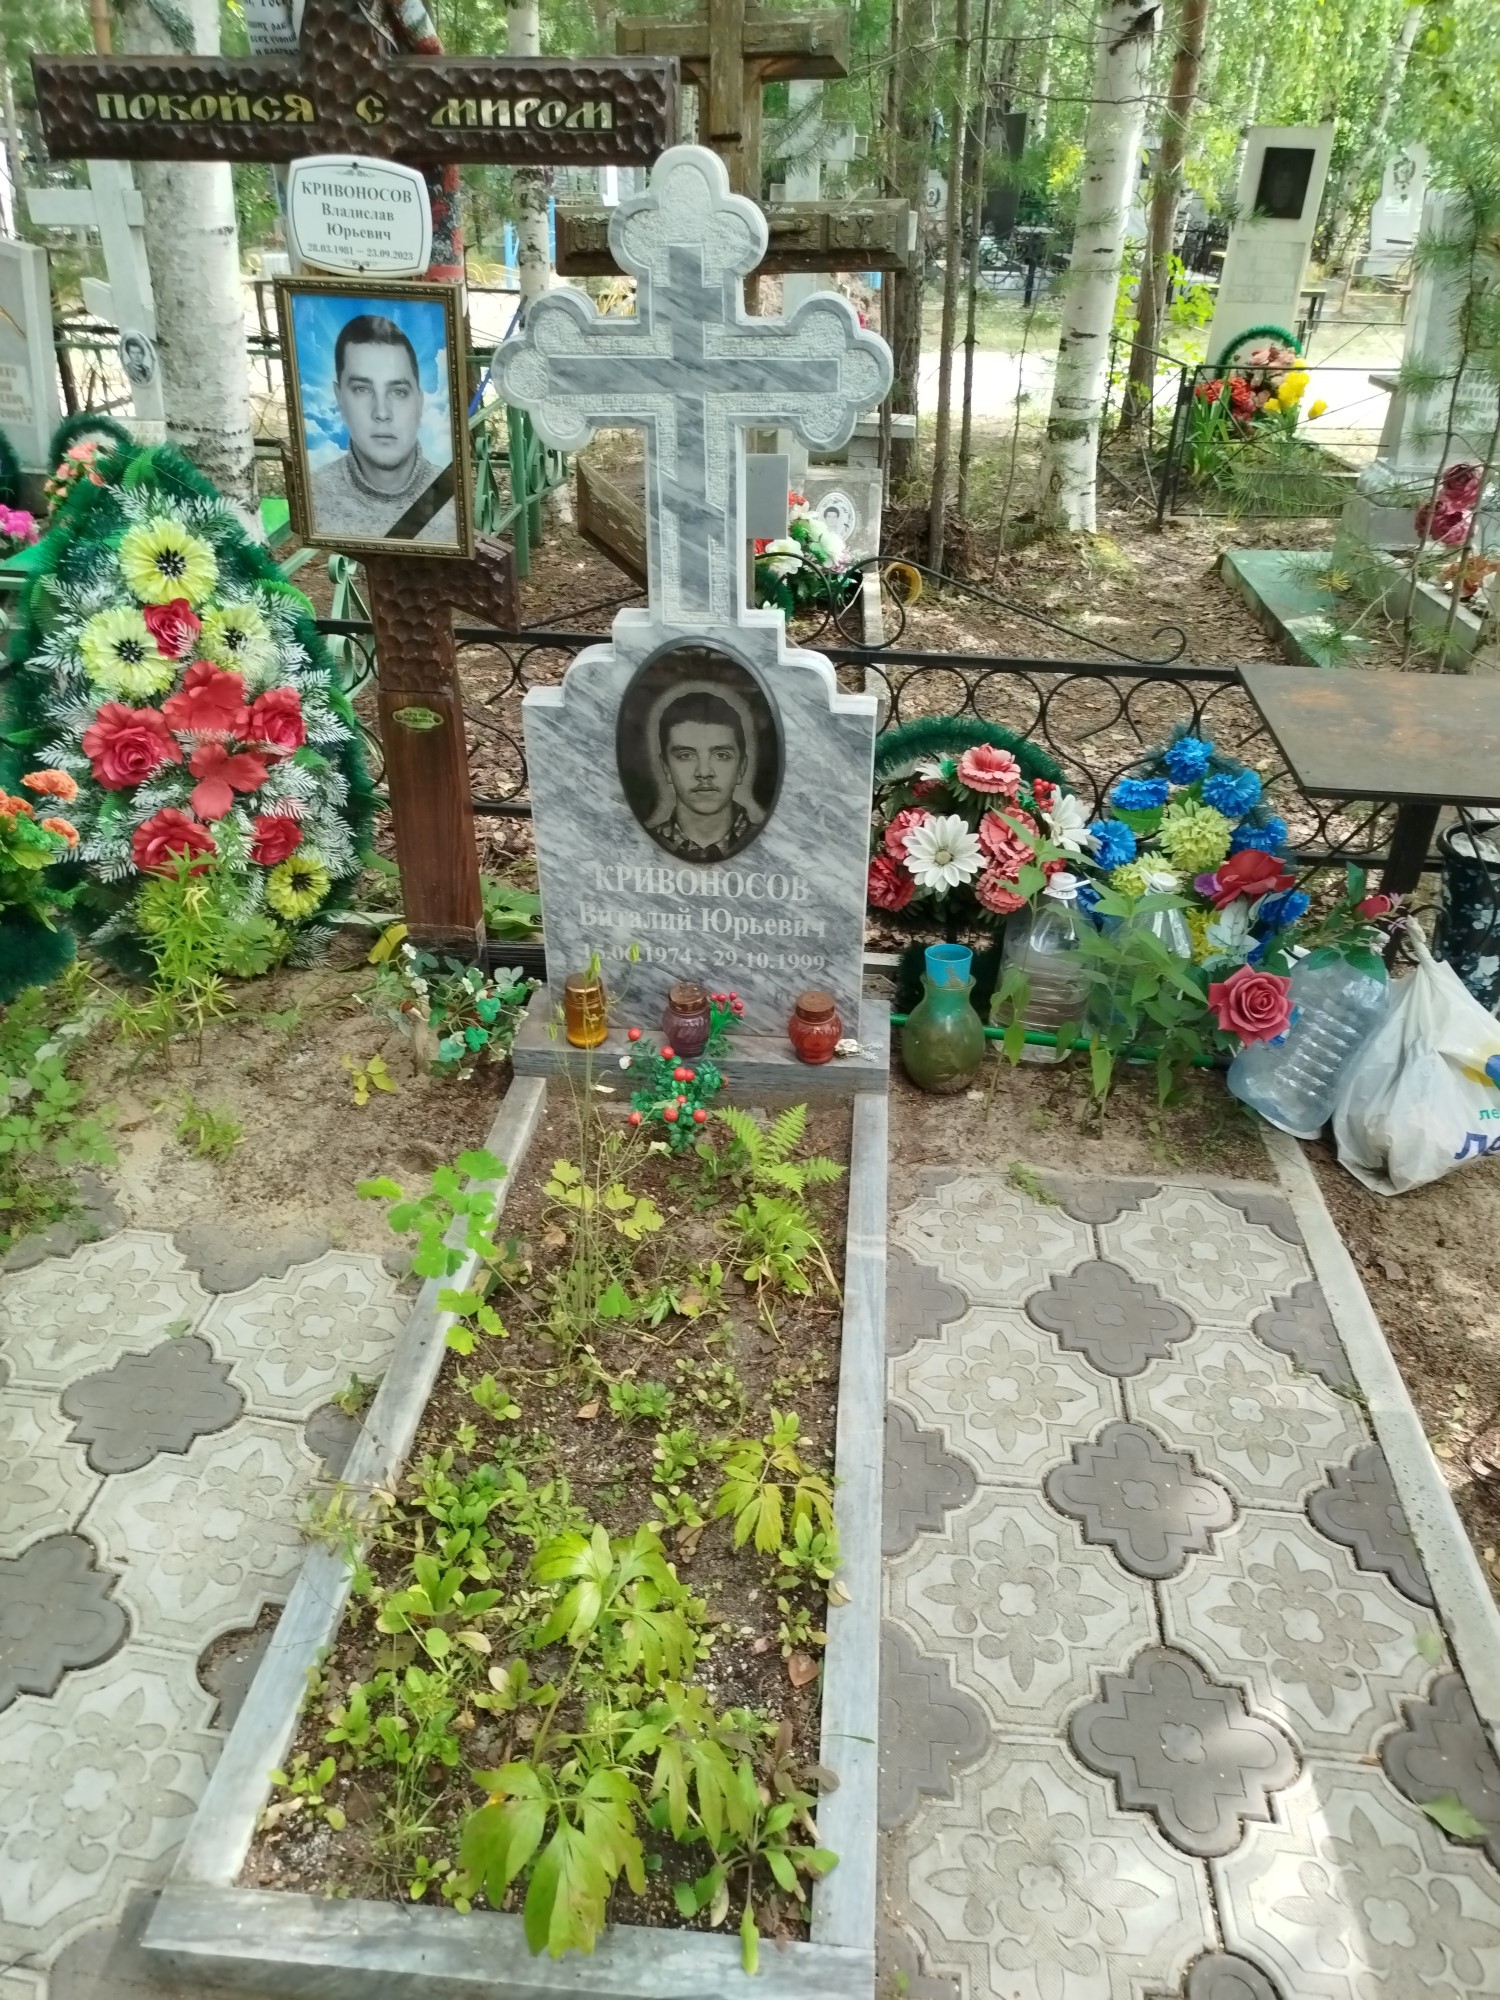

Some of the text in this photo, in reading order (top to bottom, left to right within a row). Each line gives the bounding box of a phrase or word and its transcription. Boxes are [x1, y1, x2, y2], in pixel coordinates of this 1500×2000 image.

[301, 181, 412, 203] КРИВОНОСОВ
[321, 202, 395, 222] Владислав
[326, 222, 392, 241] Юрьевич
[307, 242, 354, 255] 28.03.1981
[366, 247, 414, 260] 23.09.2023
[596, 864, 809, 901] КРИВОНОСОВ
[579, 902, 693, 932] Виталий
[702, 907, 826, 941] Юрьевич
[713, 950, 826, 972] 29.10.1999
